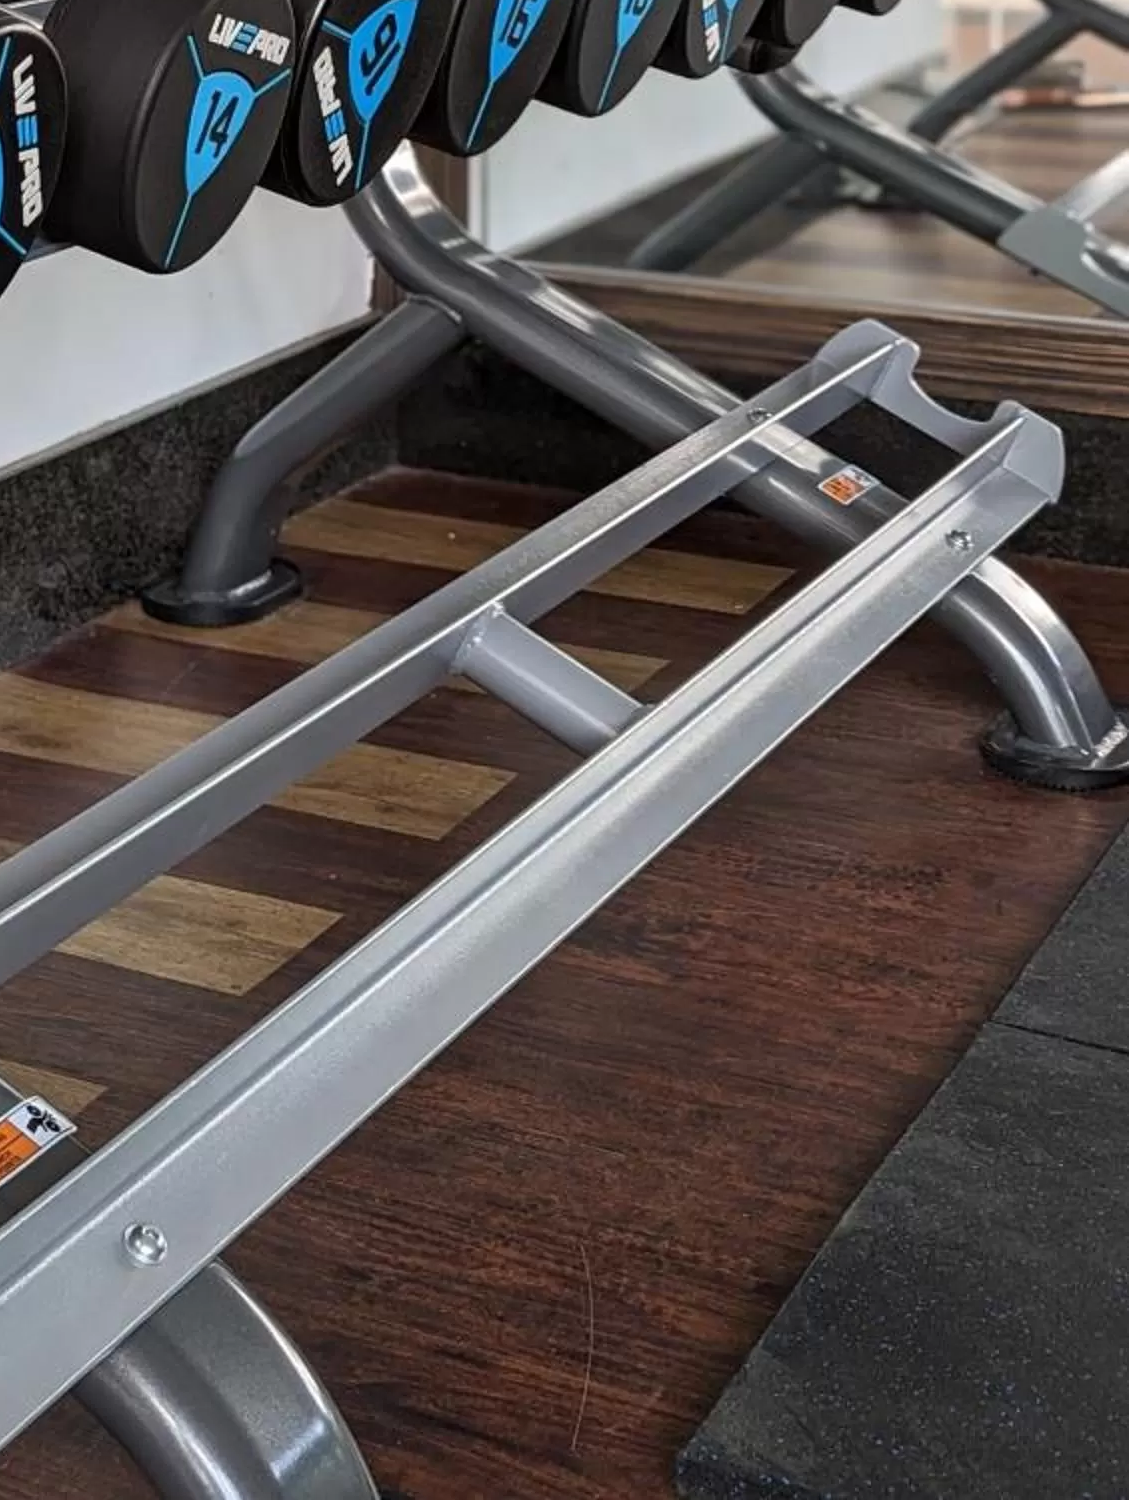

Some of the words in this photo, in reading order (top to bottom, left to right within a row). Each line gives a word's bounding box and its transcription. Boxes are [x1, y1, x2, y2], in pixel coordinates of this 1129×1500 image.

[208, 13, 291, 66] LIVEPRO
[360, 13, 401, 96] 16
[12, 54, 44, 228] LIVEPRO
[195, 89, 240, 159] 14
[313, 46, 352, 187] LIVEPRO
